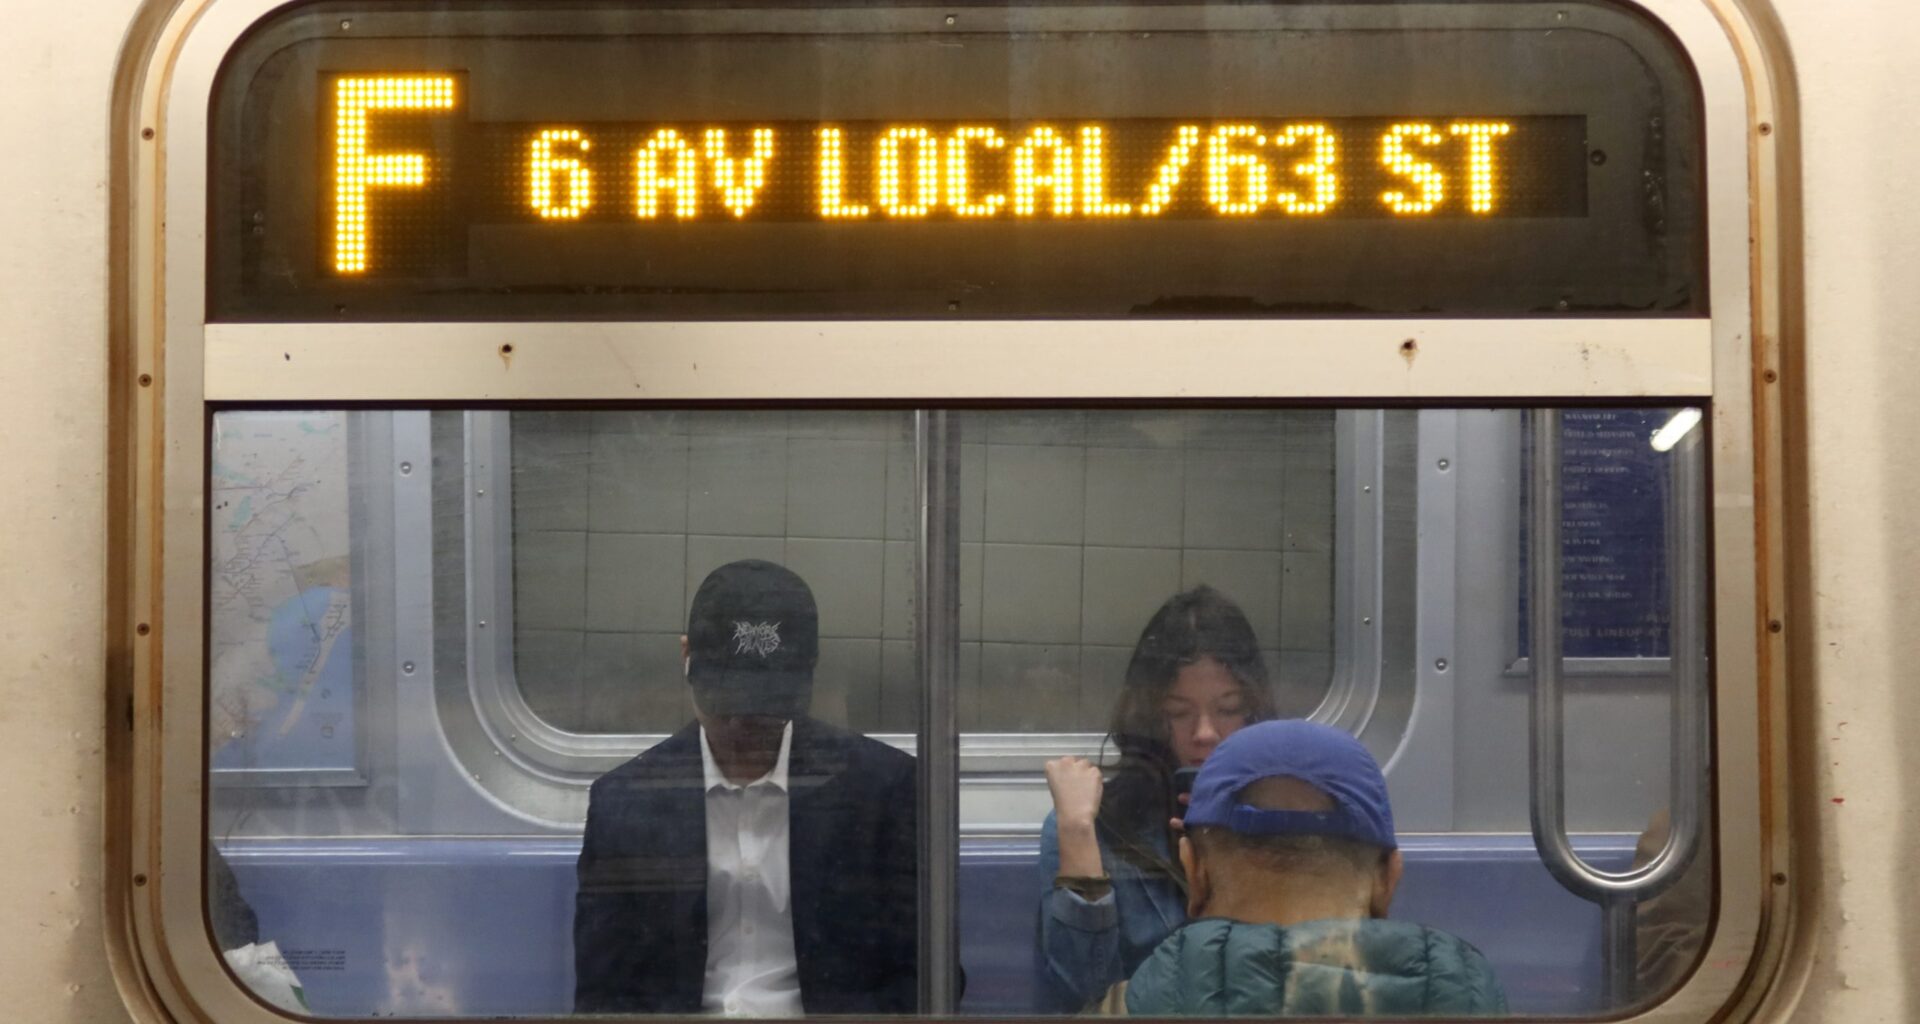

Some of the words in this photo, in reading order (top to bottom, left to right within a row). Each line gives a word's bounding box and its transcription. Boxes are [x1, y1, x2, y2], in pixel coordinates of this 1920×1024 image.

[335, 77, 455, 272] F
[530, 129, 591, 218] 6
[636, 129, 773, 218] AV
[820, 126, 1337, 217] LOCAL/63
[1382, 124, 1509, 214] ST
